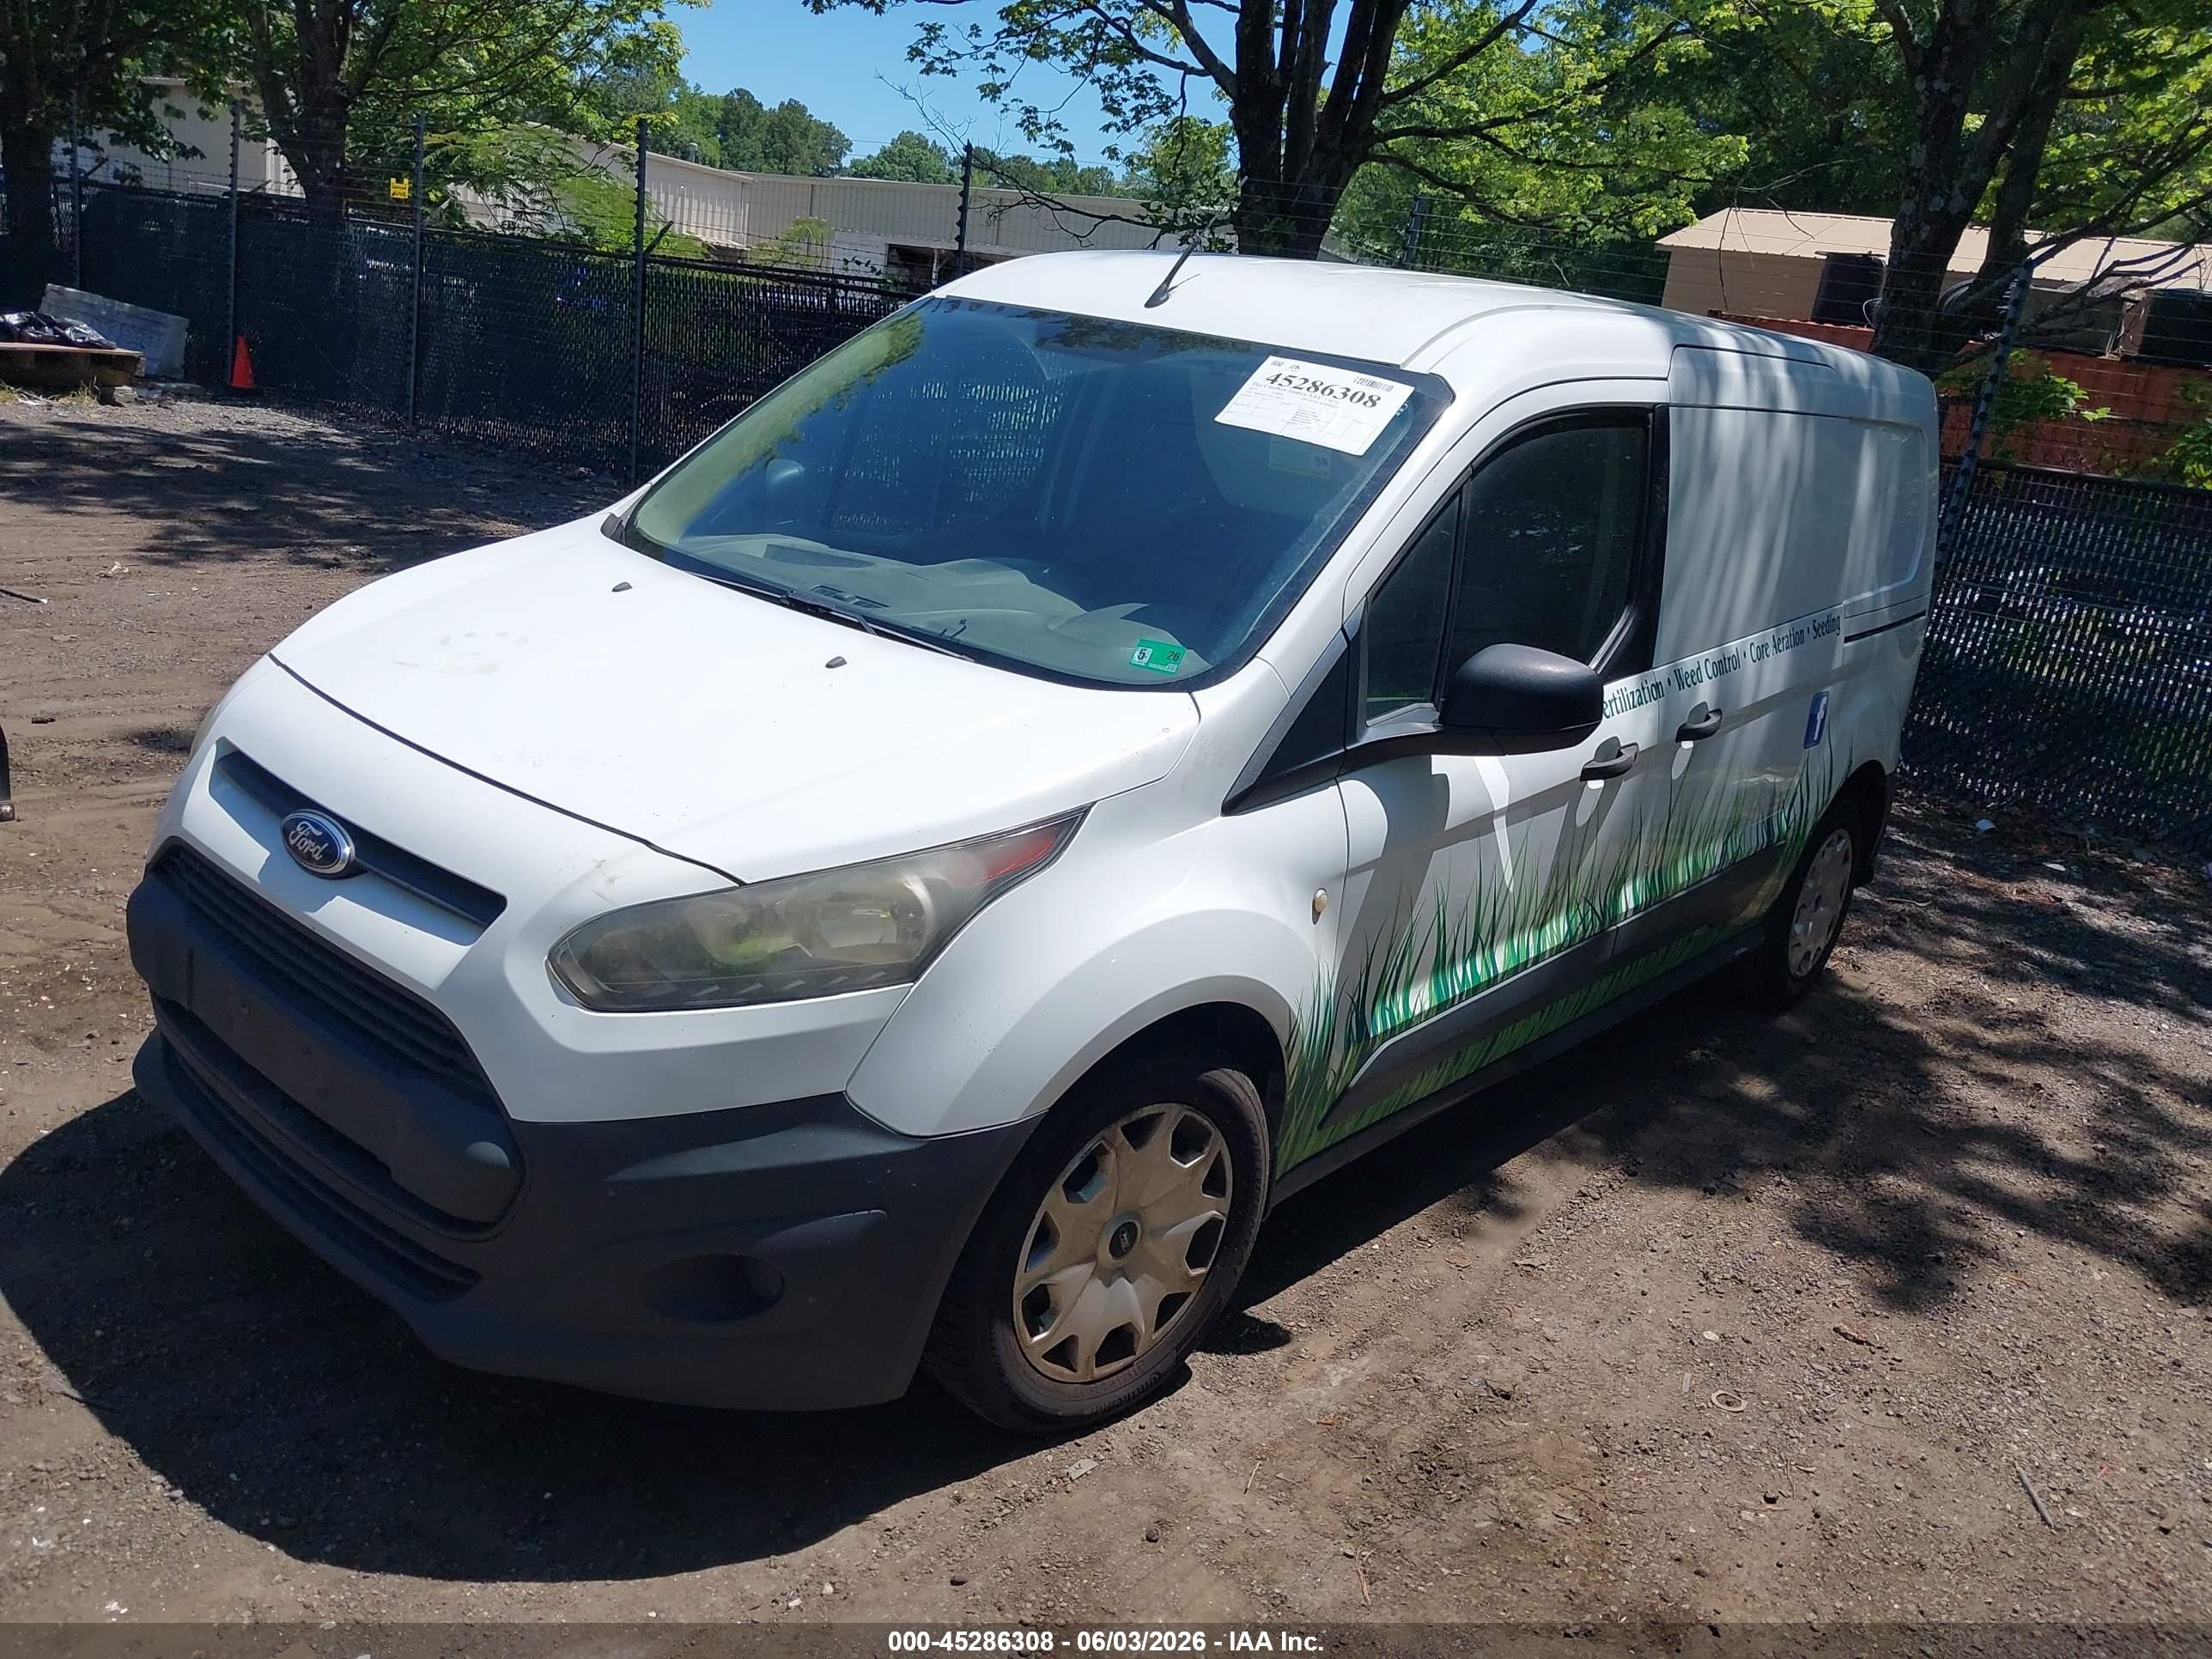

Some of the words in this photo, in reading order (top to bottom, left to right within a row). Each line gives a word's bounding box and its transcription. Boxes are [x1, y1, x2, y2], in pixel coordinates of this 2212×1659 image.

[1265, 372, 1382, 409] 45286308
[1137, 648, 1147, 660] 5
[1166, 650, 1182, 662] 26
[1603, 676, 1665, 719] ertilization
[1674, 665, 1704, 691] Weed
[1705, 647, 1742, 680] Control
[1749, 640, 1771, 664] Core
[1771, 627, 1805, 655] Aeration
[1812, 613, 1841, 640] Seeding
[288, 820, 329, 861] Ford
